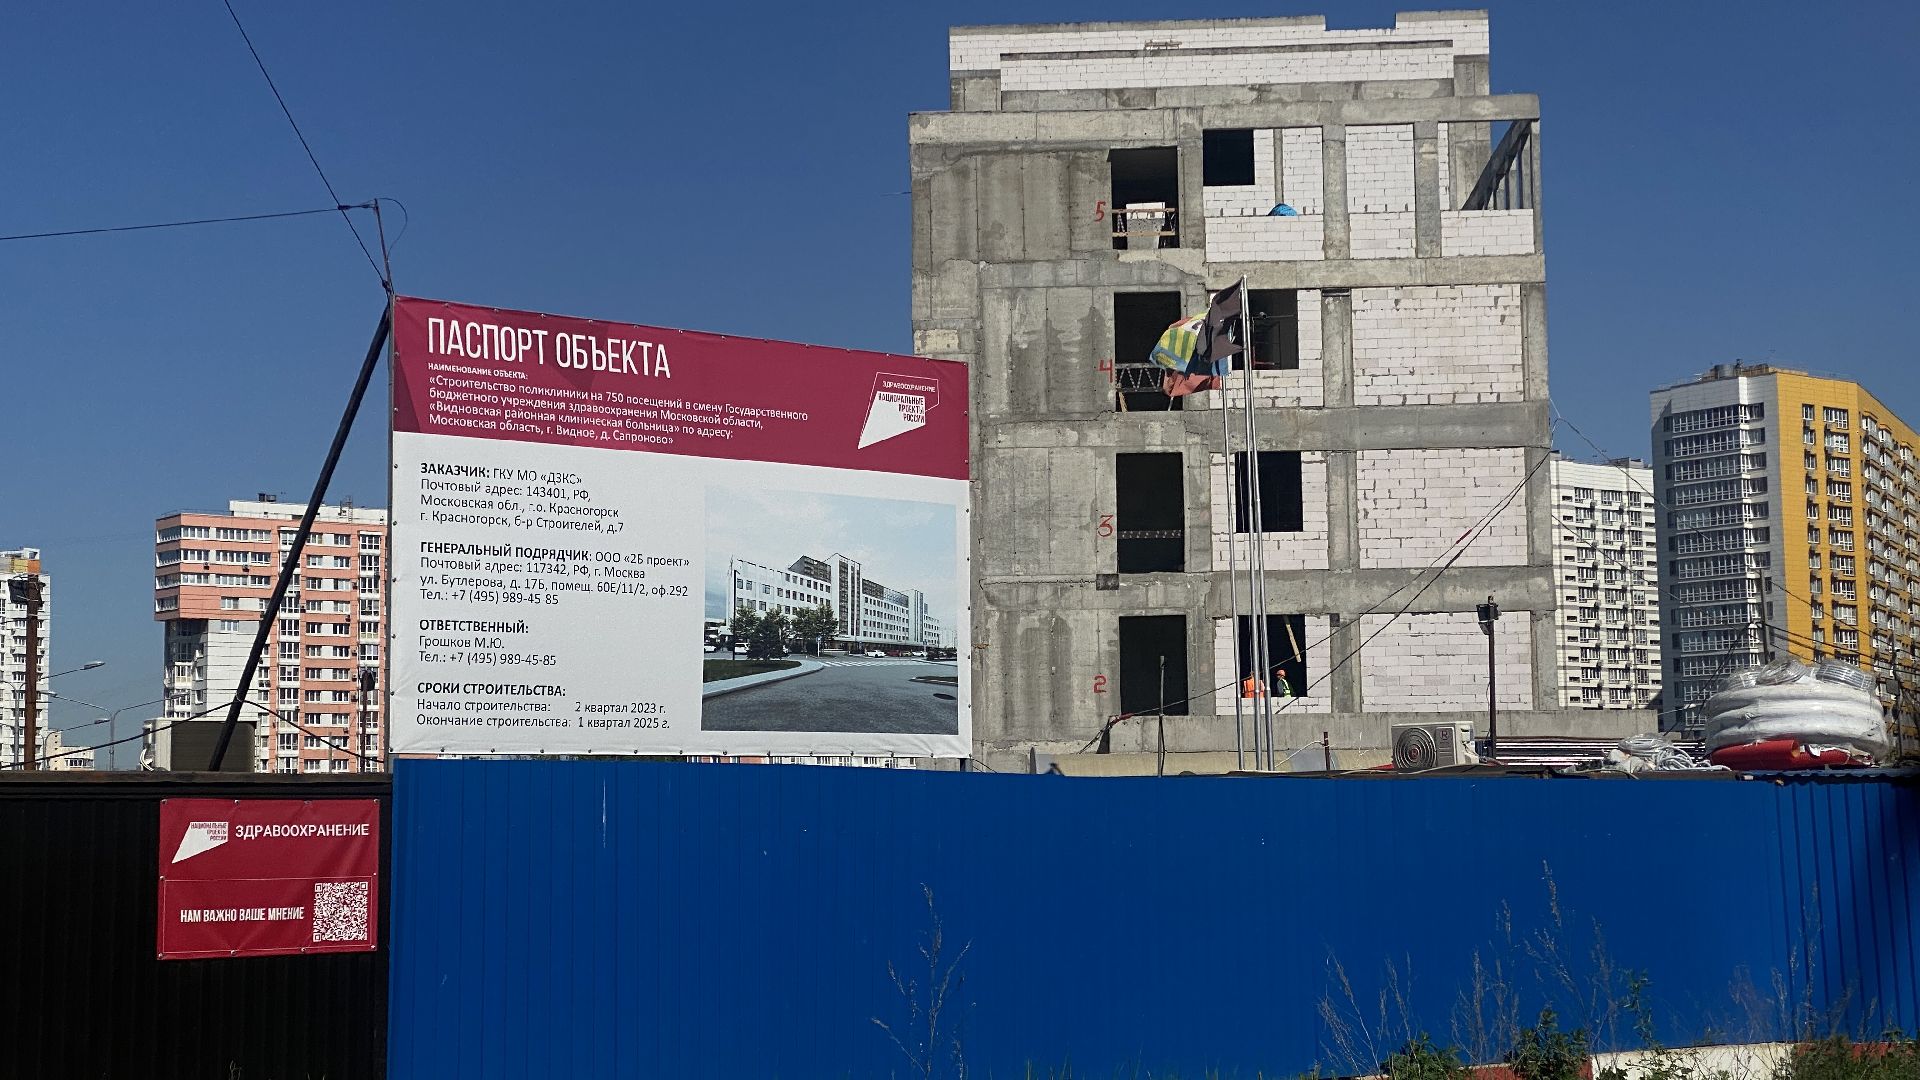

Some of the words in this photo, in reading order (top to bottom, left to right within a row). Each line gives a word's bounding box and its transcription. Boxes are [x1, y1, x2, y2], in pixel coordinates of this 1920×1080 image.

[1094, 201, 1106, 223] 5
[428, 317, 548, 365] ПАСПОРТ
[555, 332, 671, 379] ОБЪЕКТА
[428, 362, 492, 377] НАИМЕНОВАНИЕ
[494, 370, 529, 380] ОБЪЕКТА:
[1098, 359, 1113, 384] 4
[429, 388, 498, 404] бюджетного
[501, 396, 566, 411] учреждения
[568, 403, 658, 419] здравоохранения
[661, 409, 721, 425] Московской
[723, 416, 763, 430] области,
[430, 375, 516, 393] «Строительство
[519, 386, 589, 400] поликлиники
[591, 392, 603, 401] на
[605, 391, 624, 404] 750
[626, 396, 682, 410] посещений
[693, 403, 723, 413] смену
[726, 404, 808, 421] Государственного
[429, 401, 501, 417] «Видновская
[505, 409, 555, 422] районная
[558, 414, 622, 428] клиническая
[626, 419, 680, 434] больница»
[683, 425, 695, 434] по
[697, 429, 733, 439] адресу:
[429, 414, 497, 430] Московская
[500, 421, 544, 434] область,
[556, 425, 599, 440] Видное,
[600, 432, 610, 441] д.
[613, 430, 674, 445] Сапроново»
[420, 463, 490, 478] ЗАКАЗЧИК:
[493, 469, 514, 480] ГКУ
[517, 470, 537, 481] МО
[540, 472, 583, 485] «ДЗКС»
[421, 479, 481, 493] Почтовый
[485, 485, 523, 497] адрес:
[526, 486, 570, 501] 143401,
[573, 490, 591, 502] РФ,
[420, 495, 494, 509] Московская
[497, 500, 525, 514] обл.,
[549, 503, 619, 519] Красногорск
[420, 512, 428, 521] г.
[432, 511, 511, 527] Красногорск,
[514, 515, 533, 529] б-р
[537, 518, 606, 534] Строителей,
[607, 522, 624, 534] д.7
[1097, 515, 1114, 538] 3
[421, 542, 512, 557] ГЕНЕРАЛЬНЫЙ
[516, 547, 592, 562] ПОДРЯДЧИК:
[595, 552, 621, 563] ООО
[647, 557, 690, 568] проект»
[421, 557, 481, 571] Почтовый
[485, 562, 522, 574] адрес:
[527, 563, 570, 576] 117342,
[574, 565, 591, 579] РФ,
[605, 567, 645, 579] Москва
[420, 576, 438, 586] ул.
[442, 574, 506, 589] Бутлерова,
[510, 579, 521, 590] д.
[551, 582, 593, 593] помещ.
[652, 585, 688, 598] оф.292
[420, 589, 448, 601] Тел.:
[452, 590, 466, 601] +7
[469, 590, 499, 605] (495)
[502, 592, 559, 605] 989-4585
[420, 620, 529, 634] ОТВЕТСТВЕННЫЙ:
[419, 636, 471, 649] Грошков
[474, 638, 505, 649] М.Ю.
[419, 651, 446, 662] Тел.:
[450, 652, 464, 662] +7
[468, 653, 497, 666] (495)
[500, 654, 556, 666] 989-45-85
[418, 683, 460, 694] СРОКИ
[463, 684, 566, 697] СТРОИТЕЛЬСТВА:
[1093, 675, 1107, 694] 2
[418, 699, 461, 711] Начало
[465, 702, 551, 713] строительства:
[575, 702, 581, 712] 2
[585, 704, 628, 715] квартал
[631, 703, 656, 714] 2023
[660, 706, 666, 714] г.
[417, 714, 483, 726] Окончание
[486, 717, 571, 728] строительства:
[579, 717, 584, 728] 1
[588, 719, 631, 730] квартал
[634, 718, 659, 729] 2025
[235, 824, 370, 841] ЗДРАВООХРАНЕНИЕ
[180, 910, 201, 923] НАМ
[203, 909, 237, 922] ВАЖНО
[240, 908, 266, 921] ВАШЕ
[268, 907, 305, 921] МНЕНИЕ
